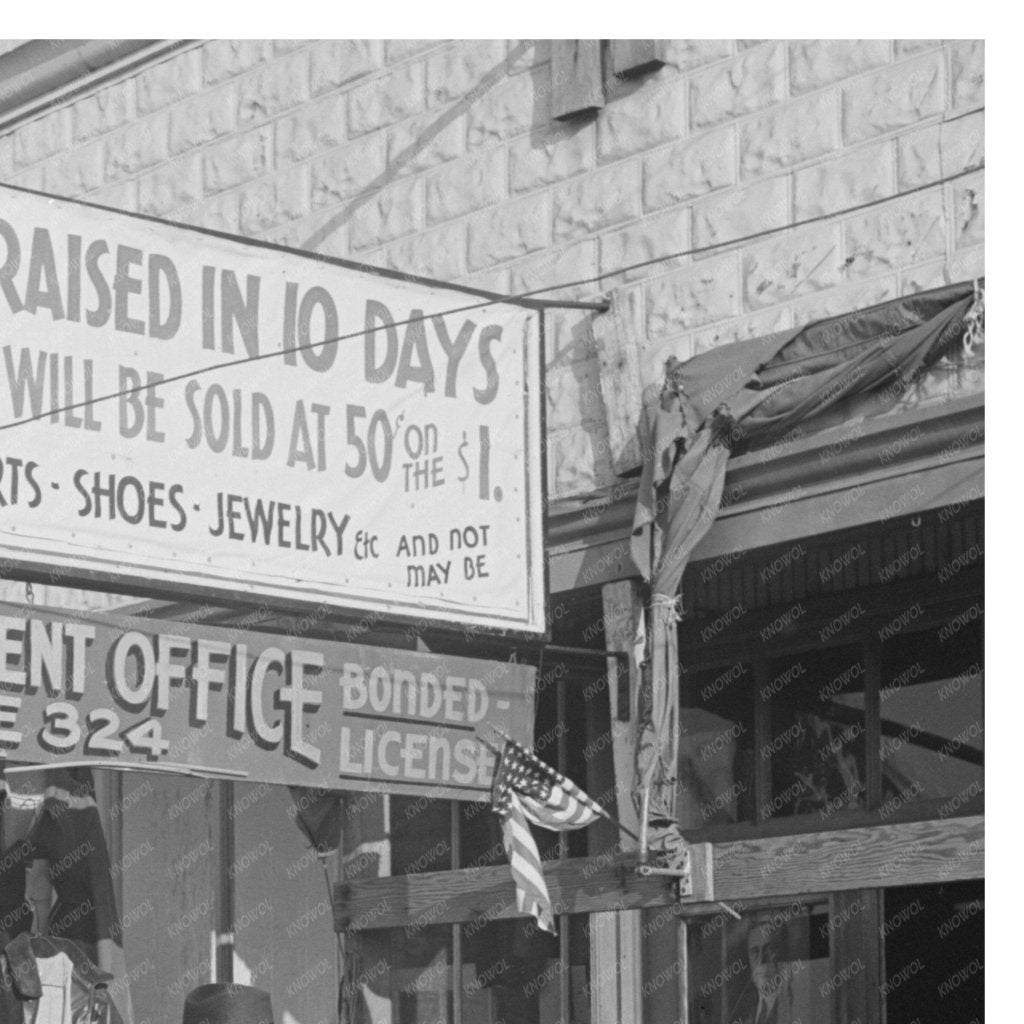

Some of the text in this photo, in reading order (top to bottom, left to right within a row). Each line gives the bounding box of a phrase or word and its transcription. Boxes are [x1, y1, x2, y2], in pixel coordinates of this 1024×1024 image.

[201, 265, 261, 358] IN
[282, 280, 339, 373] 10
[364, 299, 503, 405] DAYS
[2, 345, 102, 432] WILL
[119, 364, 166, 443] BE
[184, 379, 275, 461] SOLD
[286, 399, 330, 472] AT
[402, 456, 445, 493] THE
[73, 469, 186, 532] SHOES
[208, 491, 350, 557] JEWELRY
[396, 533, 439, 557] AND
[407, 554, 489, 587] MAY BE
[43, 703, 170, 757] 324
[111, 632, 324, 766] OFFICE
